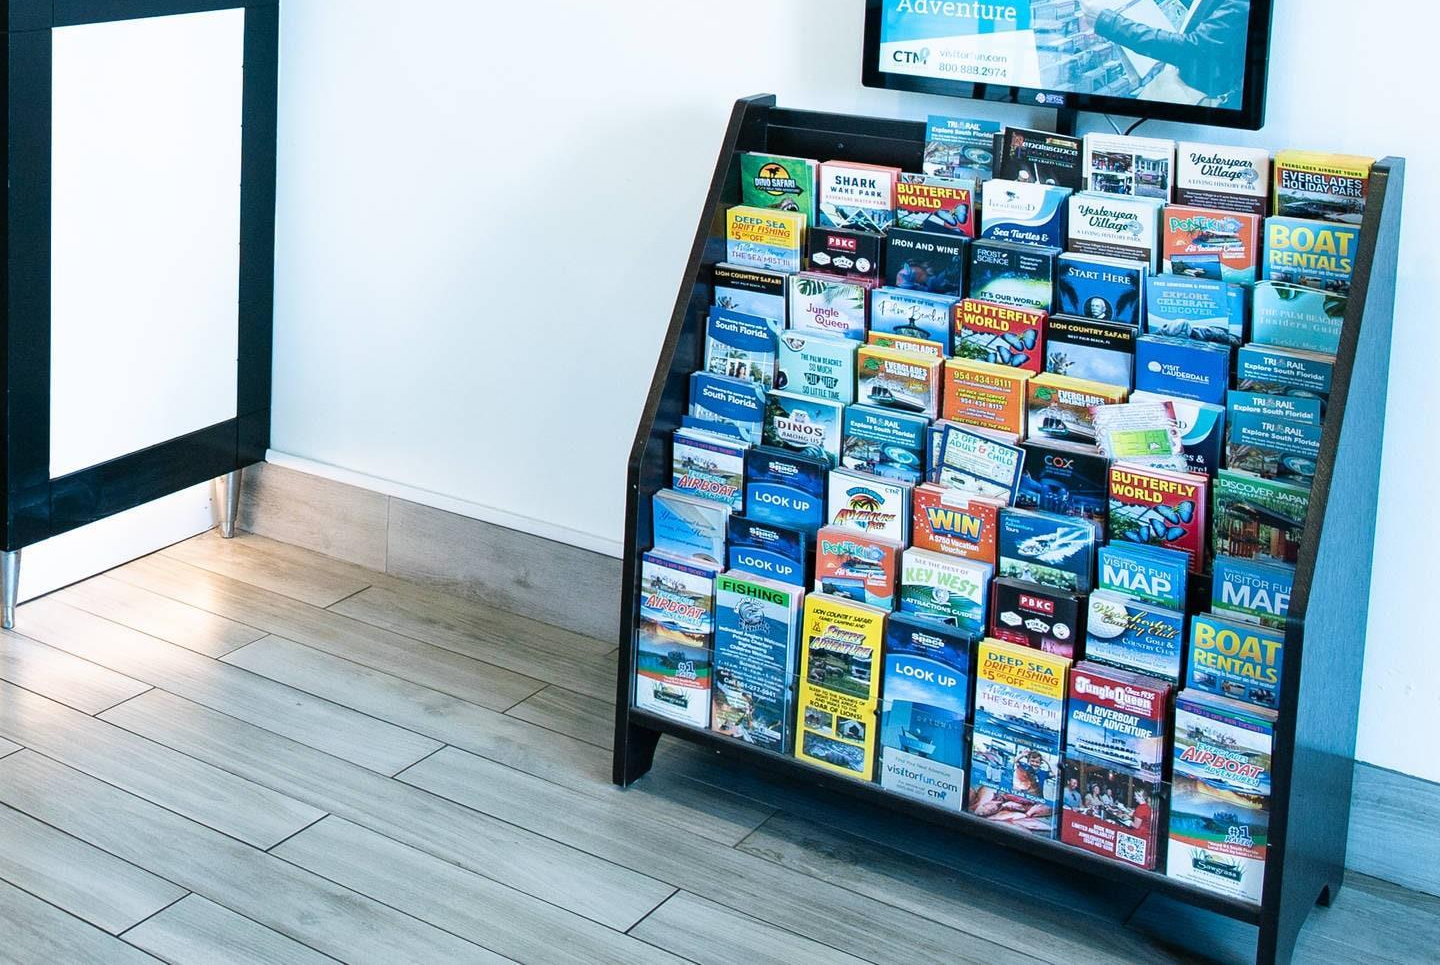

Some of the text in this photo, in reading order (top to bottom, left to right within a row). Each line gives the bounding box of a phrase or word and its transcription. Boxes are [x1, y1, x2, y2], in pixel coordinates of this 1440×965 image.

[940, 50, 1007, 63] visitorun.com
[1190, 153, 1253, 169] Yesteryear
[1201, 166, 1242, 180] Village
[1282, 170, 1362, 189] EVERGLADES
[835, 175, 876, 189] SHARK
[1282, 179, 1362, 197] HOLIDAY PARK
[830, 186, 882, 198] WAKE PARK
[897, 184, 968, 200] BUTTERFLY
[898, 195, 942, 209] WORLD
[1078, 204, 1138, 220] Yesteryear
[732, 222, 791, 237] DRIFT FISHING
[735, 215, 786, 230] DEEP SEA
[1089, 216, 1128, 232] Village
[828, 237, 854, 248] PBKC
[892, 239, 959, 255] IRON AND WINE
[1270, 225, 1354, 256] BOAT
[977, 249, 1000, 258] FROST
[977, 255, 1009, 266] SCIENCE
[1270, 249, 1351, 273] RENTALS
[730, 271, 759, 282] COUNTRY
[760, 276, 782, 285] SAFARI
[1068, 268, 1131, 284] START HERE
[806, 303, 840, 317] Jungle
[963, 302, 1040, 326] BUTTERFLY
[716, 321, 769, 339] South Florida.
[815, 315, 849, 329] Queen
[963, 314, 1009, 331] WORLD
[1049, 322, 1066, 330] LION
[1067, 324, 1102, 335] COUNTRY
[1103, 329, 1130, 340] SAFARI
[885, 361, 928, 377] EVERGLADES
[1244, 362, 1324, 380] Explore South Florida!
[1263, 357, 1305, 370] TRI RAIL
[954, 371, 1012, 388] 954-434-8111
[1162, 369, 1209, 382] LAUDERDALE
[703, 388, 758, 409] South Florida.
[1058, 390, 1105, 405] EVERGLADES
[1253, 398, 1294, 409] TRI RAIL
[1234, 404, 1313, 419] Explore South Florida!
[778, 420, 822, 436] DINOS
[1242, 428, 1269, 438] Explore
[1271, 432, 1292, 441] South
[1285, 425, 1303, 436] RAIL
[950, 439, 976, 453] ADULT
[987, 452, 1013, 466] CHILD
[1044, 455, 1073, 469] COX
[677, 474, 737, 496] AIRBOAT
[1112, 471, 1195, 496] BUTTERFLY
[1221, 479, 1273, 497] DISCOVER
[1111, 484, 1163, 502] WORLD
[755, 492, 809, 511] LOOK UP
[927, 508, 980, 539] WIN
[940, 544, 967, 557] Voucher
[738, 555, 792, 575] LOOK UP
[1103, 557, 1171, 579] VISITOR FUN
[906, 567, 979, 596] KEY WEST
[1104, 565, 1171, 597] MAP
[722, 580, 784, 604] FISHING
[646, 594, 705, 618] AIRBOAT
[1021, 597, 1052, 610] PBKC
[827, 611, 852, 619] COUNTRY
[854, 616, 873, 624] SAFARI
[1195, 623, 1282, 665] BOAT
[988, 652, 1053, 676] DEEP SEA
[1194, 649, 1277, 684] RENTALS
[896, 663, 956, 687] LOOK UP
[984, 660, 1059, 686] DRIFT FISHING
[1006, 676, 1024, 688] OFF
[810, 700, 828, 710] ROAR
[1086, 705, 1139, 726] A RIVERBOAT
[1073, 711, 1152, 739] CRUISE ADVENTURE
[1180, 747, 1263, 778] AIRBOAT
[887, 764, 958, 792] visitorfun.com
[1228, 826, 1248, 841] #1
[1196, 860, 1238, 878] Sawgrass
